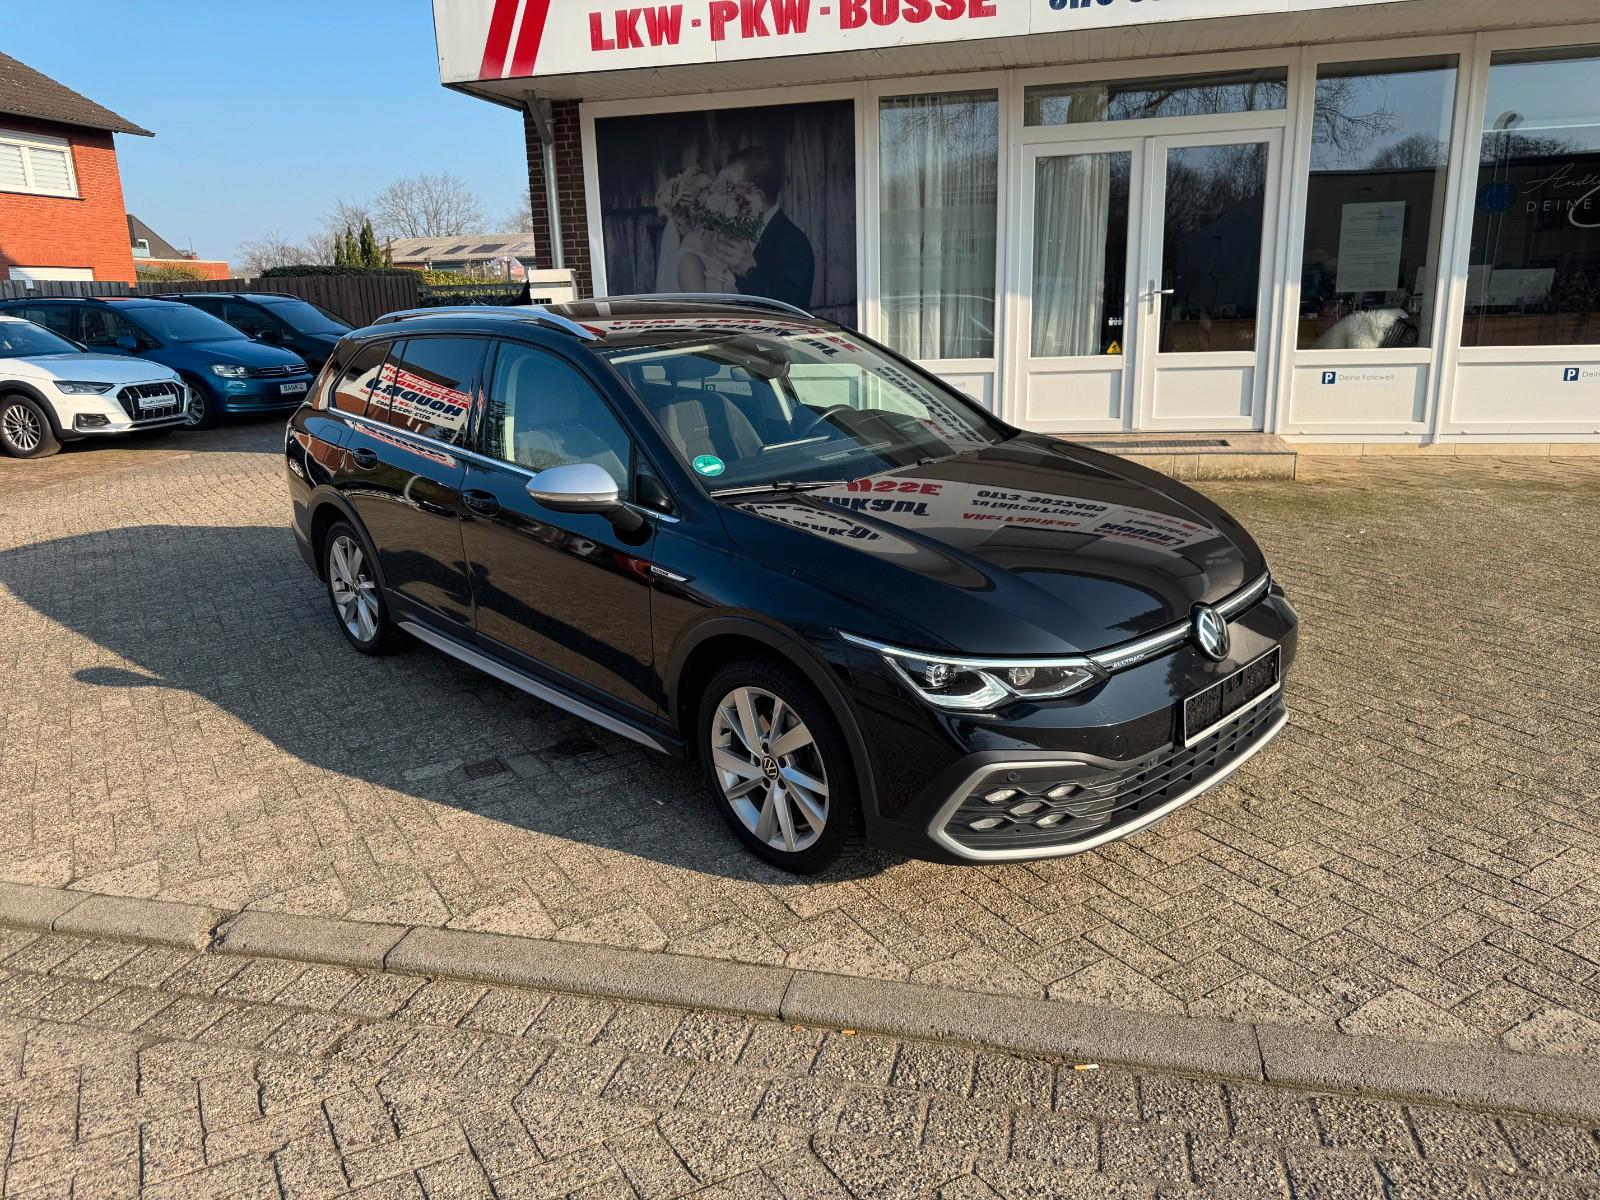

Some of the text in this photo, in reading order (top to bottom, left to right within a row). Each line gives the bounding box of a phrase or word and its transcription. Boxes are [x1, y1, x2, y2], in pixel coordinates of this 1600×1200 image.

[589, 5, 683, 51] LKW
[709, 0, 810, 41] PKW
[1527, 199, 1592, 212] DEINE
[1112, 653, 1145, 668] ALLTRACK
